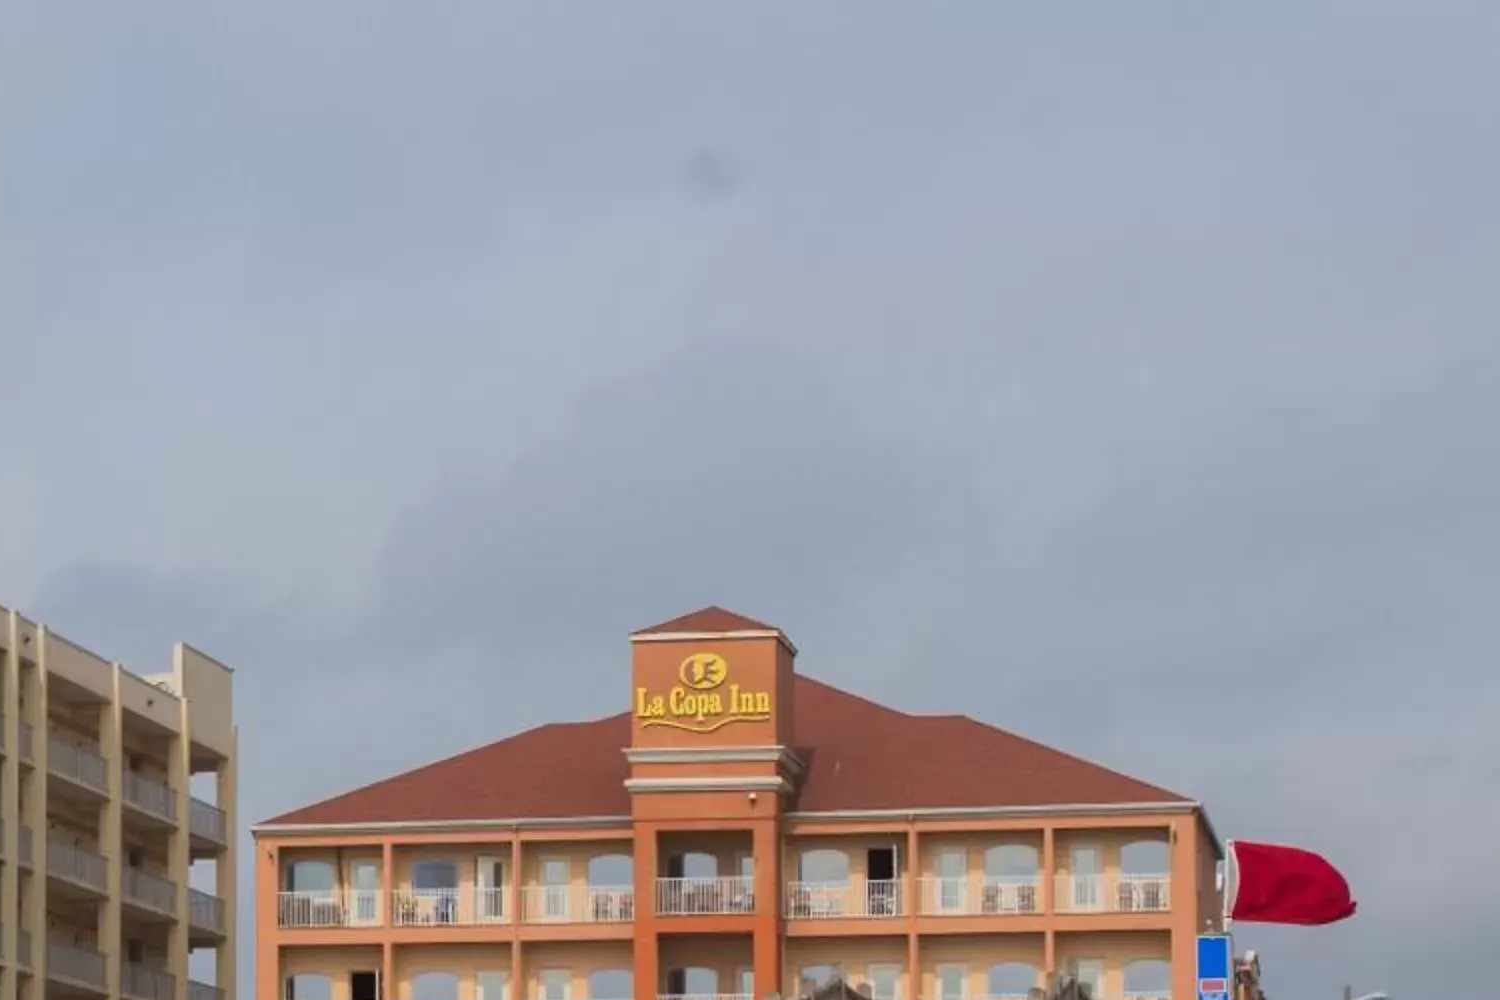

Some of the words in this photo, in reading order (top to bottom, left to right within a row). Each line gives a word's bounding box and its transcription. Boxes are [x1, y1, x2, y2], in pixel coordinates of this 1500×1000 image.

[636, 687, 665, 717] La
[670, 687, 723, 722] Copa
[730, 684, 770, 713] Inn
